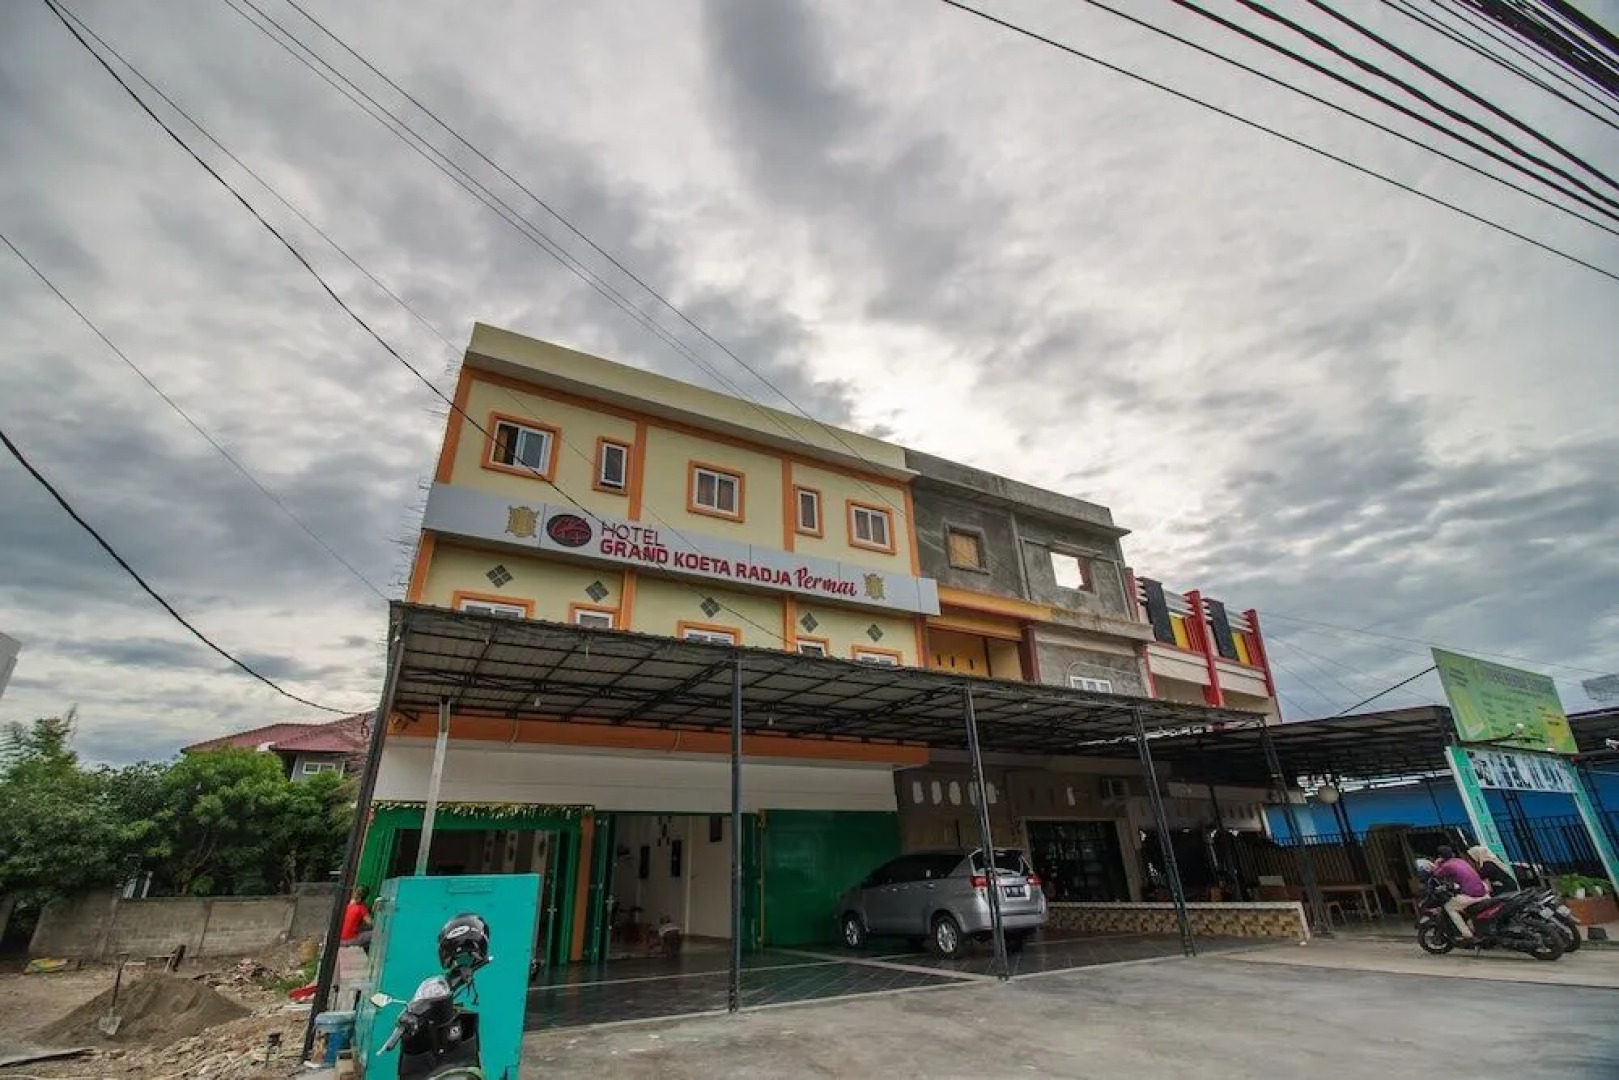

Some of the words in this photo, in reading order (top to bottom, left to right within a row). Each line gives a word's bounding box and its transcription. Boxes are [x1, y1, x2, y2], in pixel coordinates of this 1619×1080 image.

[601, 521, 665, 546] HOTEL
[601, 539, 668, 563] GRAND
[674, 551, 731, 576] KOETA
[736, 563, 792, 586] RADJA
[793, 567, 857, 596] Permai
